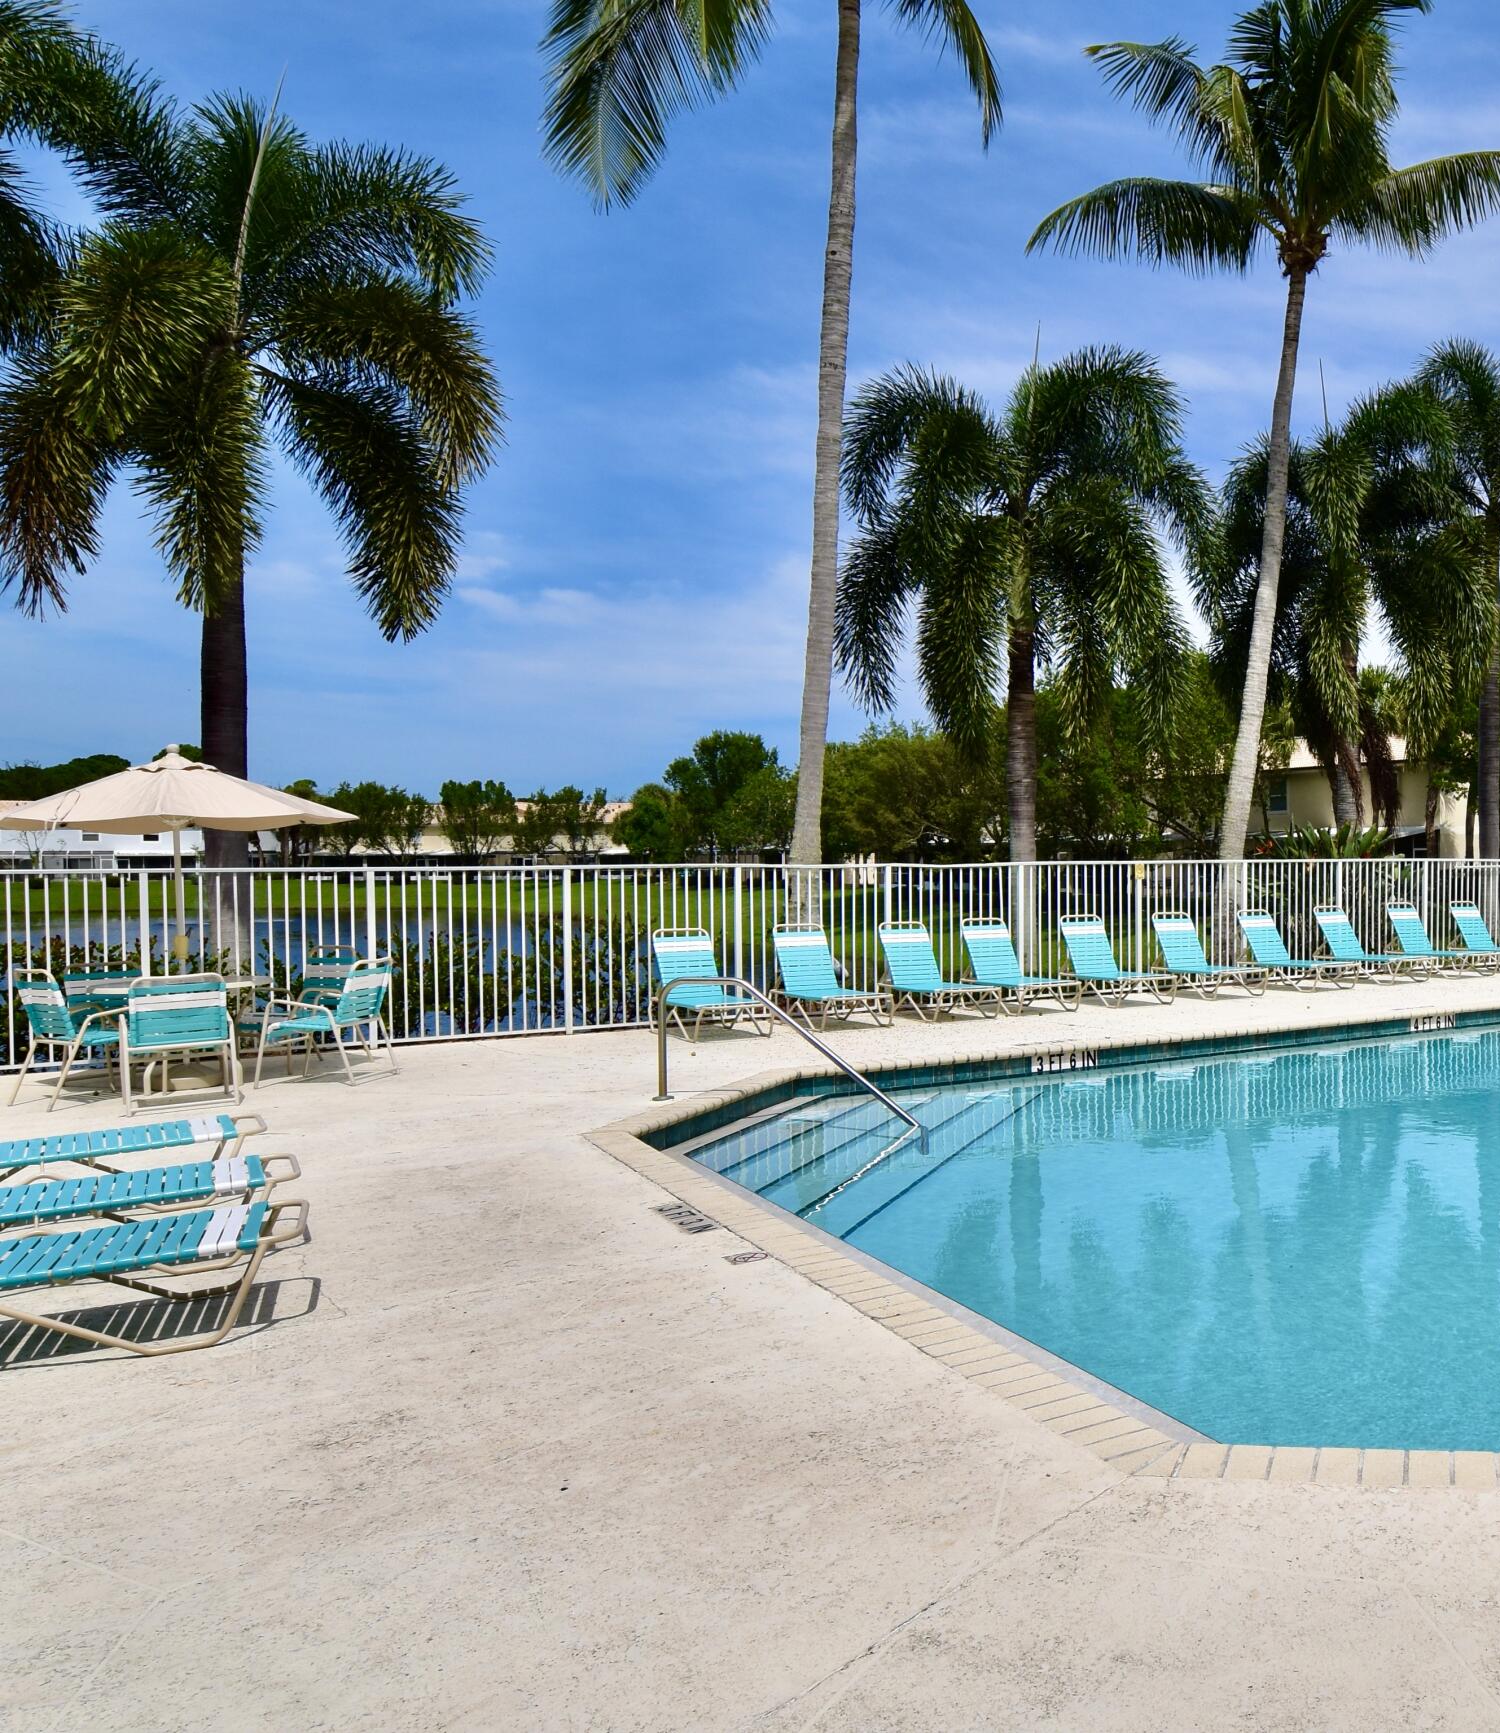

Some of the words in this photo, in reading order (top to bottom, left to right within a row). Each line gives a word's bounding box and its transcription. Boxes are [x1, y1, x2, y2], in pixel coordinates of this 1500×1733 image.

[1413, 1017, 1419, 1032] 4
[1423, 1016, 1433, 1031] FT
[1444, 1014, 1455, 1029] IN
[1036, 1056, 1044, 1075] 3
[1048, 1053, 1065, 1074] FT
[1069, 1053, 1077, 1072] 6
[1081, 1049, 1097, 1071] IN
